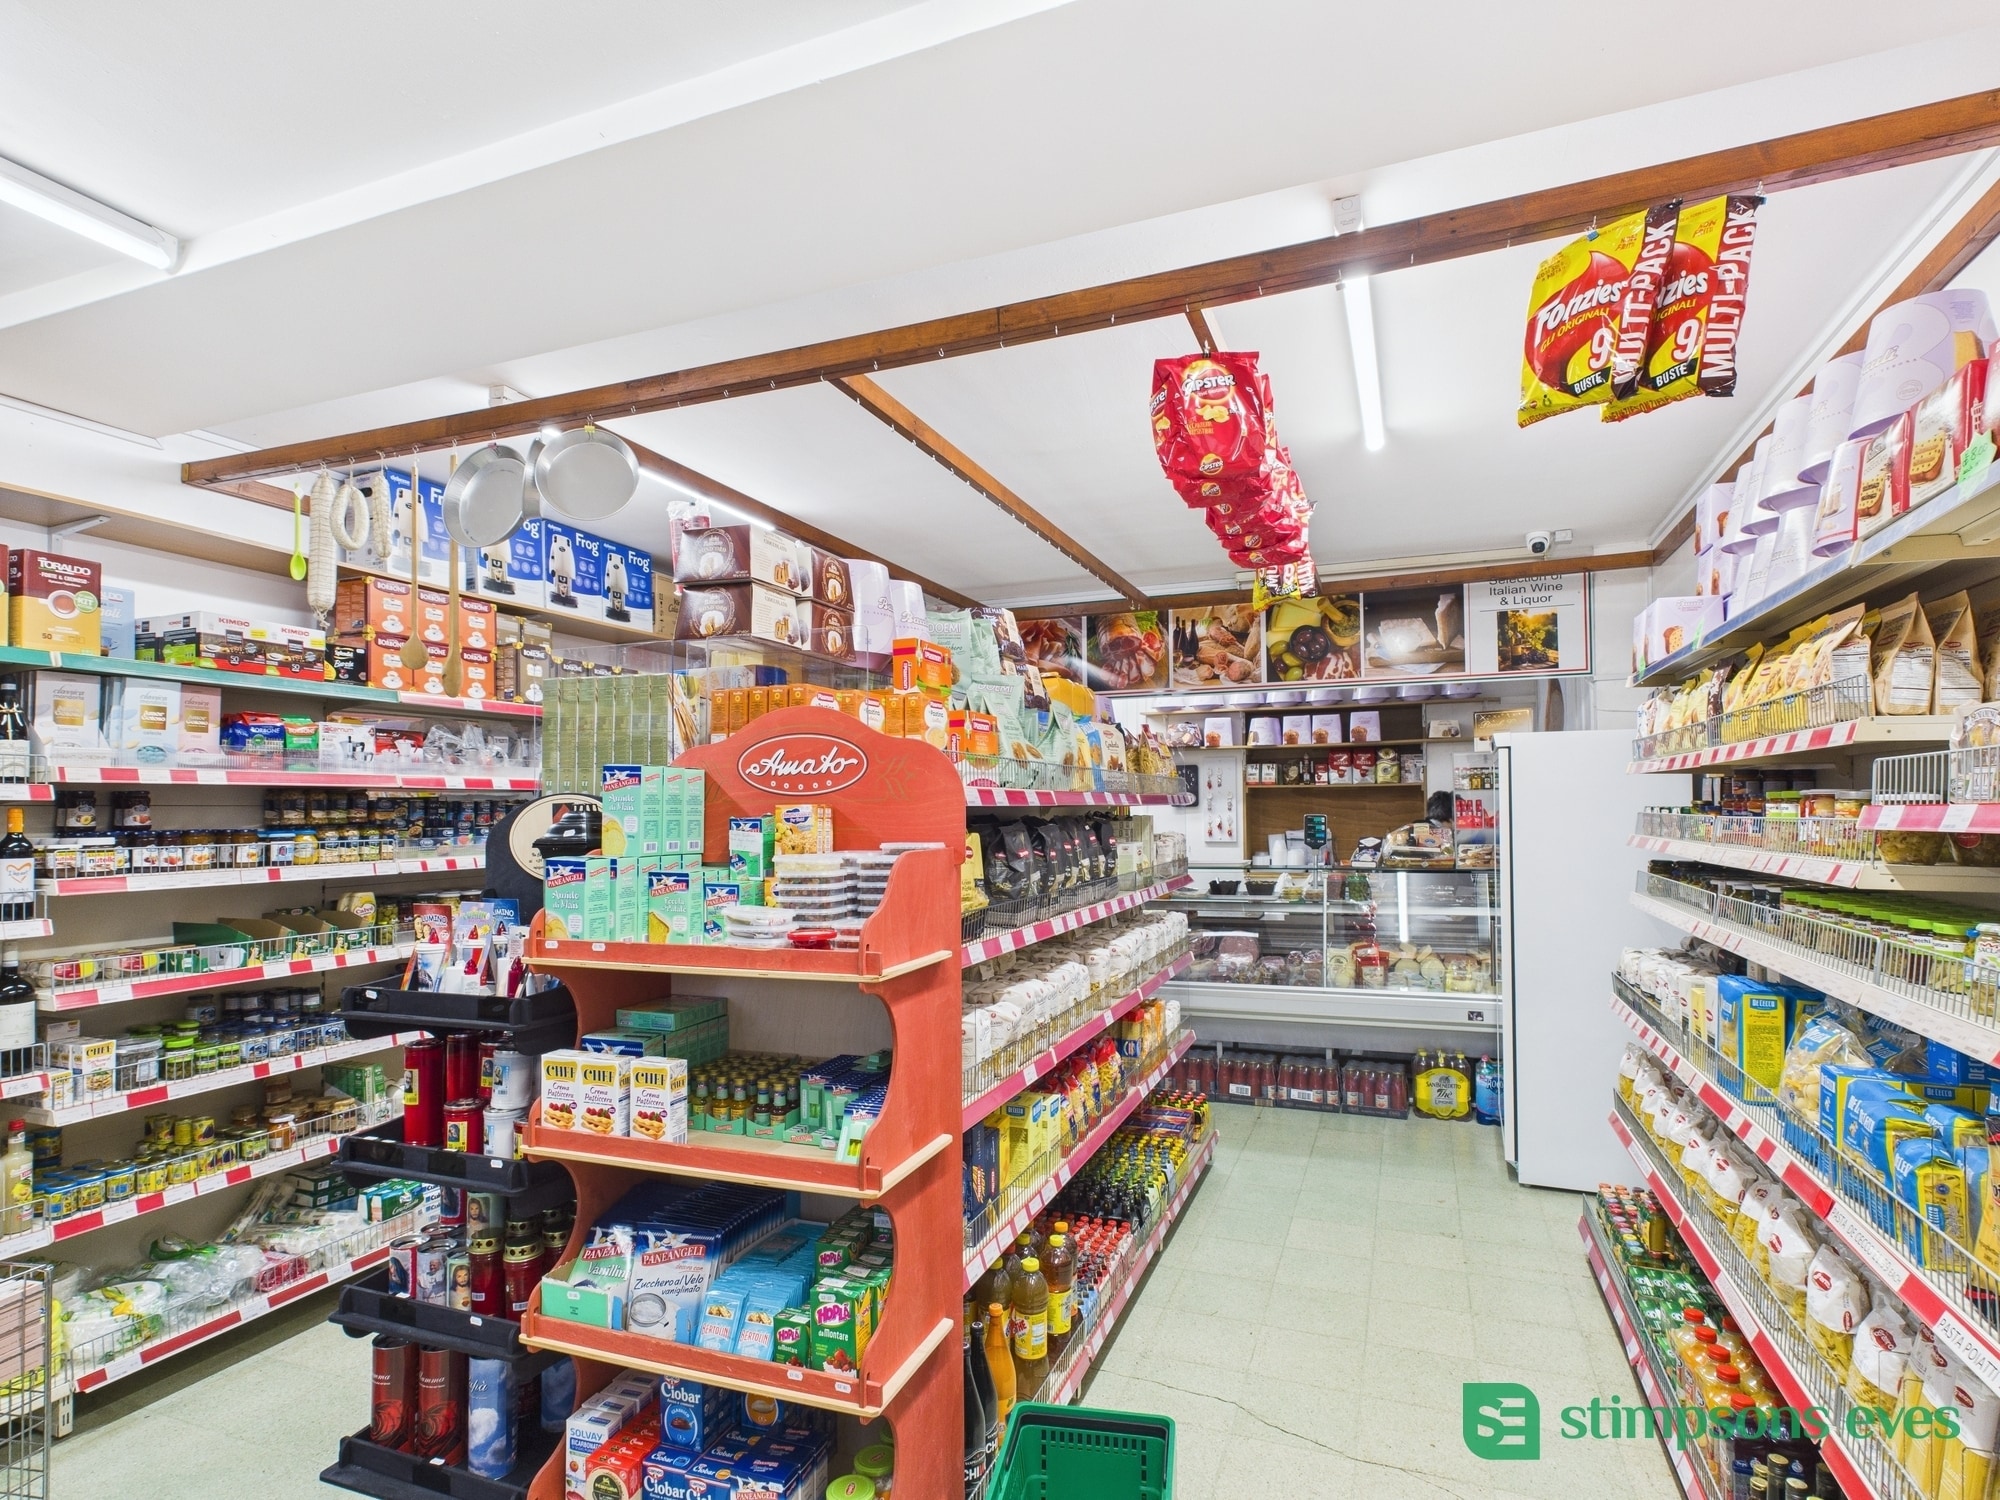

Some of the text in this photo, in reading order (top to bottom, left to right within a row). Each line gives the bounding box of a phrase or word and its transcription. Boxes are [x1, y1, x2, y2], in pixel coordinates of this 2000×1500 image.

[1701, 203, 1756, 379] MULTI-PACK
[1673, 319, 1702, 360] 9
[1589, 327, 1615, 370] 9
[1574, 372, 1602, 395] BUSTE
[1656, 365, 1689, 388] BUSTE
[431, 486, 444, 505] Fr
[575, 532, 601, 558] Frog
[37, 557, 92, 576] TORALDO
[628, 550, 651, 573] Frog
[1489, 582, 1563, 597] Italian Wine
[463, 601, 490, 613] BORBONE
[1499, 593, 1553, 607] & Liquor
[218, 617, 250, 628] KIMBO
[281, 628, 310, 637] KIMBO
[230, 655, 240, 663] 50
[463, 652, 489, 663] BORBONE
[746, 744, 859, 777] Amato
[603, 777, 640, 793] PANEANGELI
[547, 872, 584, 889] PANEANGELI
[650, 882, 688, 897] PANEANGELI
[421, 914, 448, 924] LUMINO
[492, 909, 515, 918] UMINO
[546, 1064, 577, 1079] CHEF
[583, 1068, 614, 1083] CHEF
[635, 1071, 666, 1086] CHEF
[1831, 1208, 1847, 1228] PASTA
[1846, 1224, 1857, 1235] DE
[643, 1246, 705, 1266] PANEANGELI
[634, 1278, 672, 1291] Zucchero
[684, 1274, 704, 1285] Velo
[661, 1284, 701, 1298] vaniglinato
[1939, 1318, 1965, 1346] PASTA
[661, 1383, 701, 1404] Ciobar
[570, 1427, 603, 1442] SOLVAY
[643, 1475, 686, 1499] Ciobar
